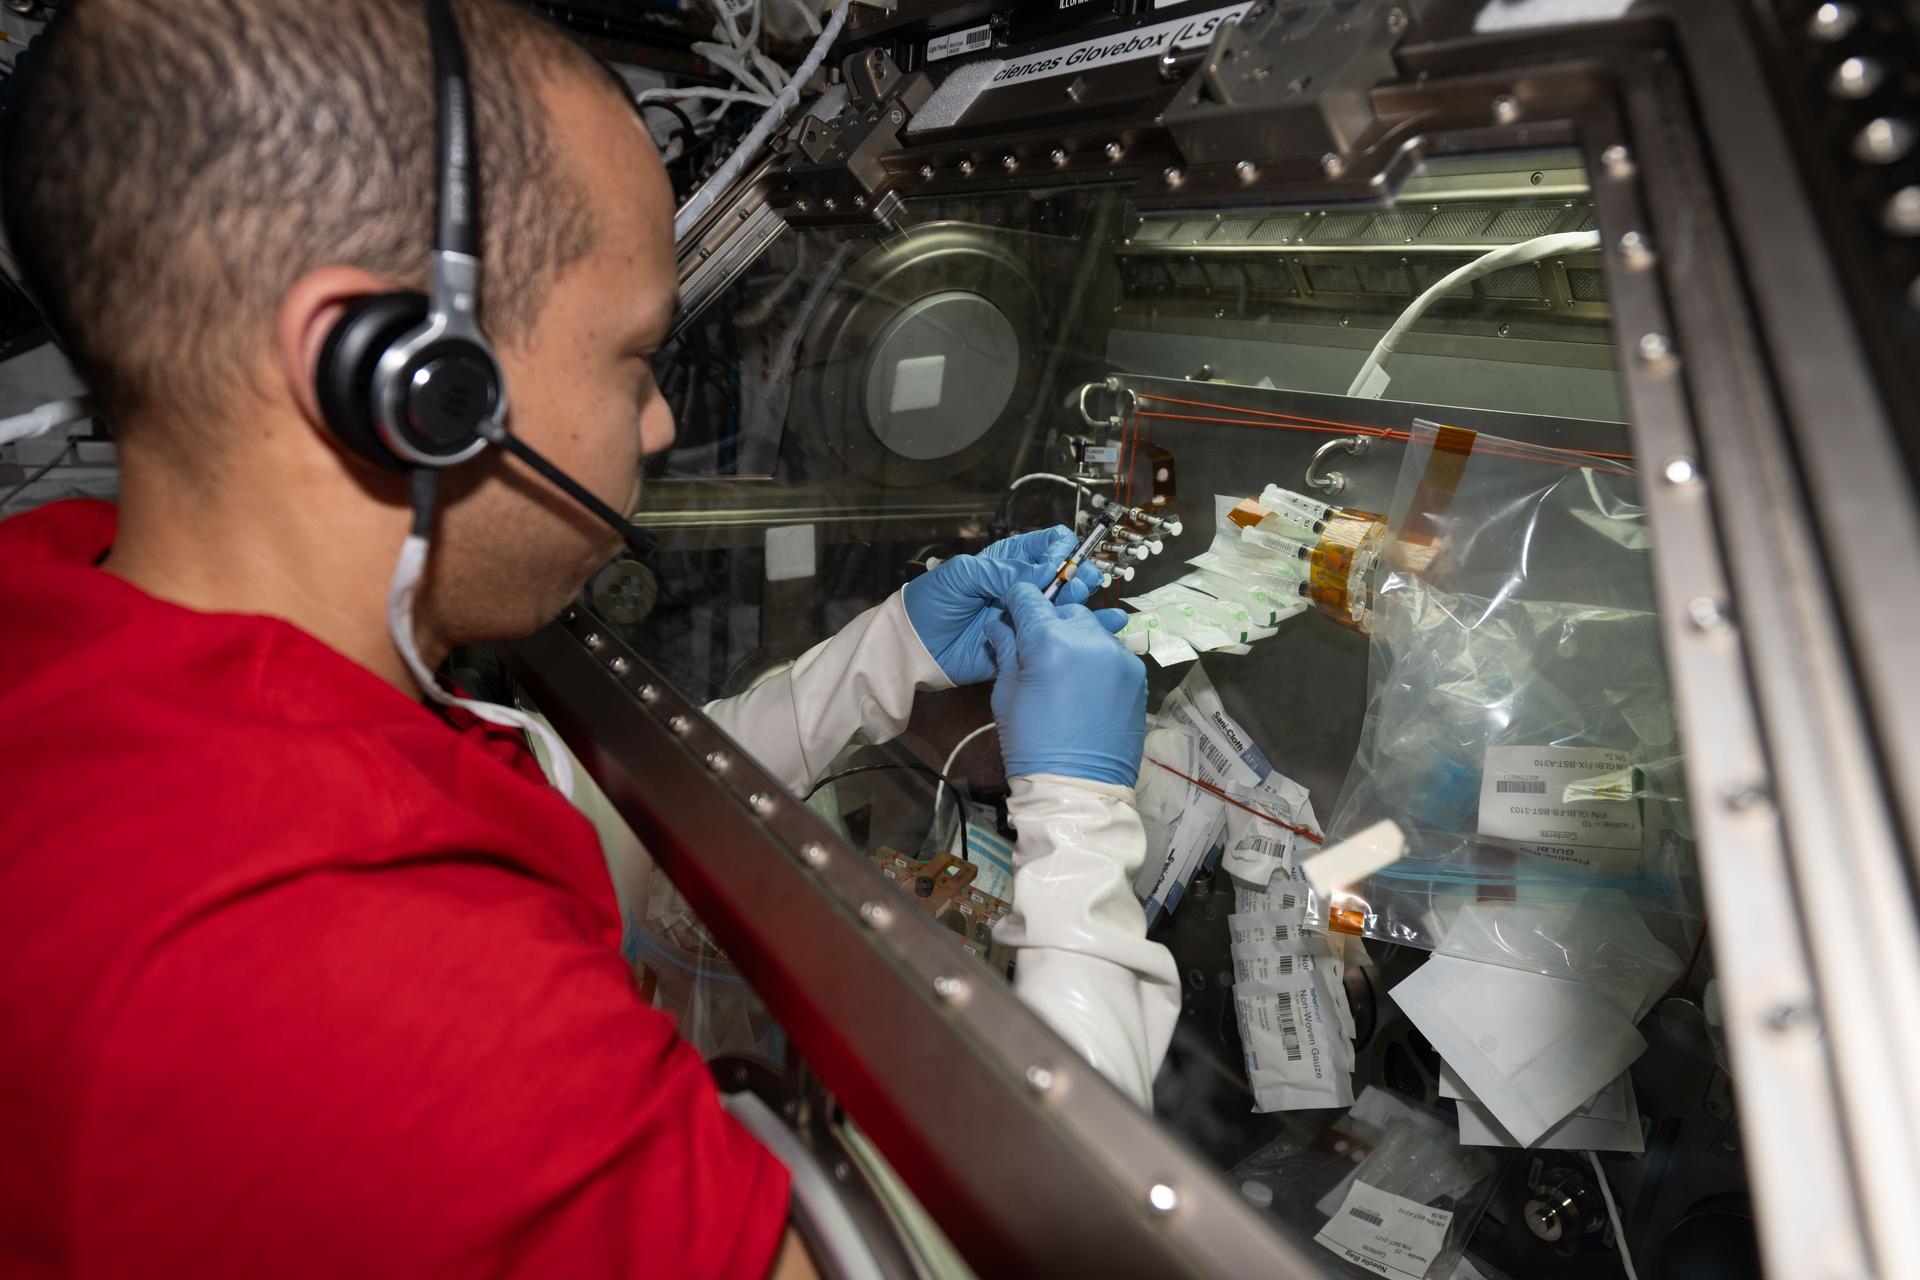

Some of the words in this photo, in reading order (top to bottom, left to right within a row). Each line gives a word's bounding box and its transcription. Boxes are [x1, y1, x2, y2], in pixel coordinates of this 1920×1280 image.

[993, 57, 1063, 82] ciences
[1065, 32, 1170, 66] Glovebox
[1213, 711, 1243, 752] Sani-Cloth
[1541, 830, 1578, 841] Contents
[1299, 989, 1316, 1046] Non-Woven
[1311, 1047, 1323, 1080] Gauze
[1345, 1249, 1361, 1262] Bag
[1361, 1257, 1388, 1274] Needle
